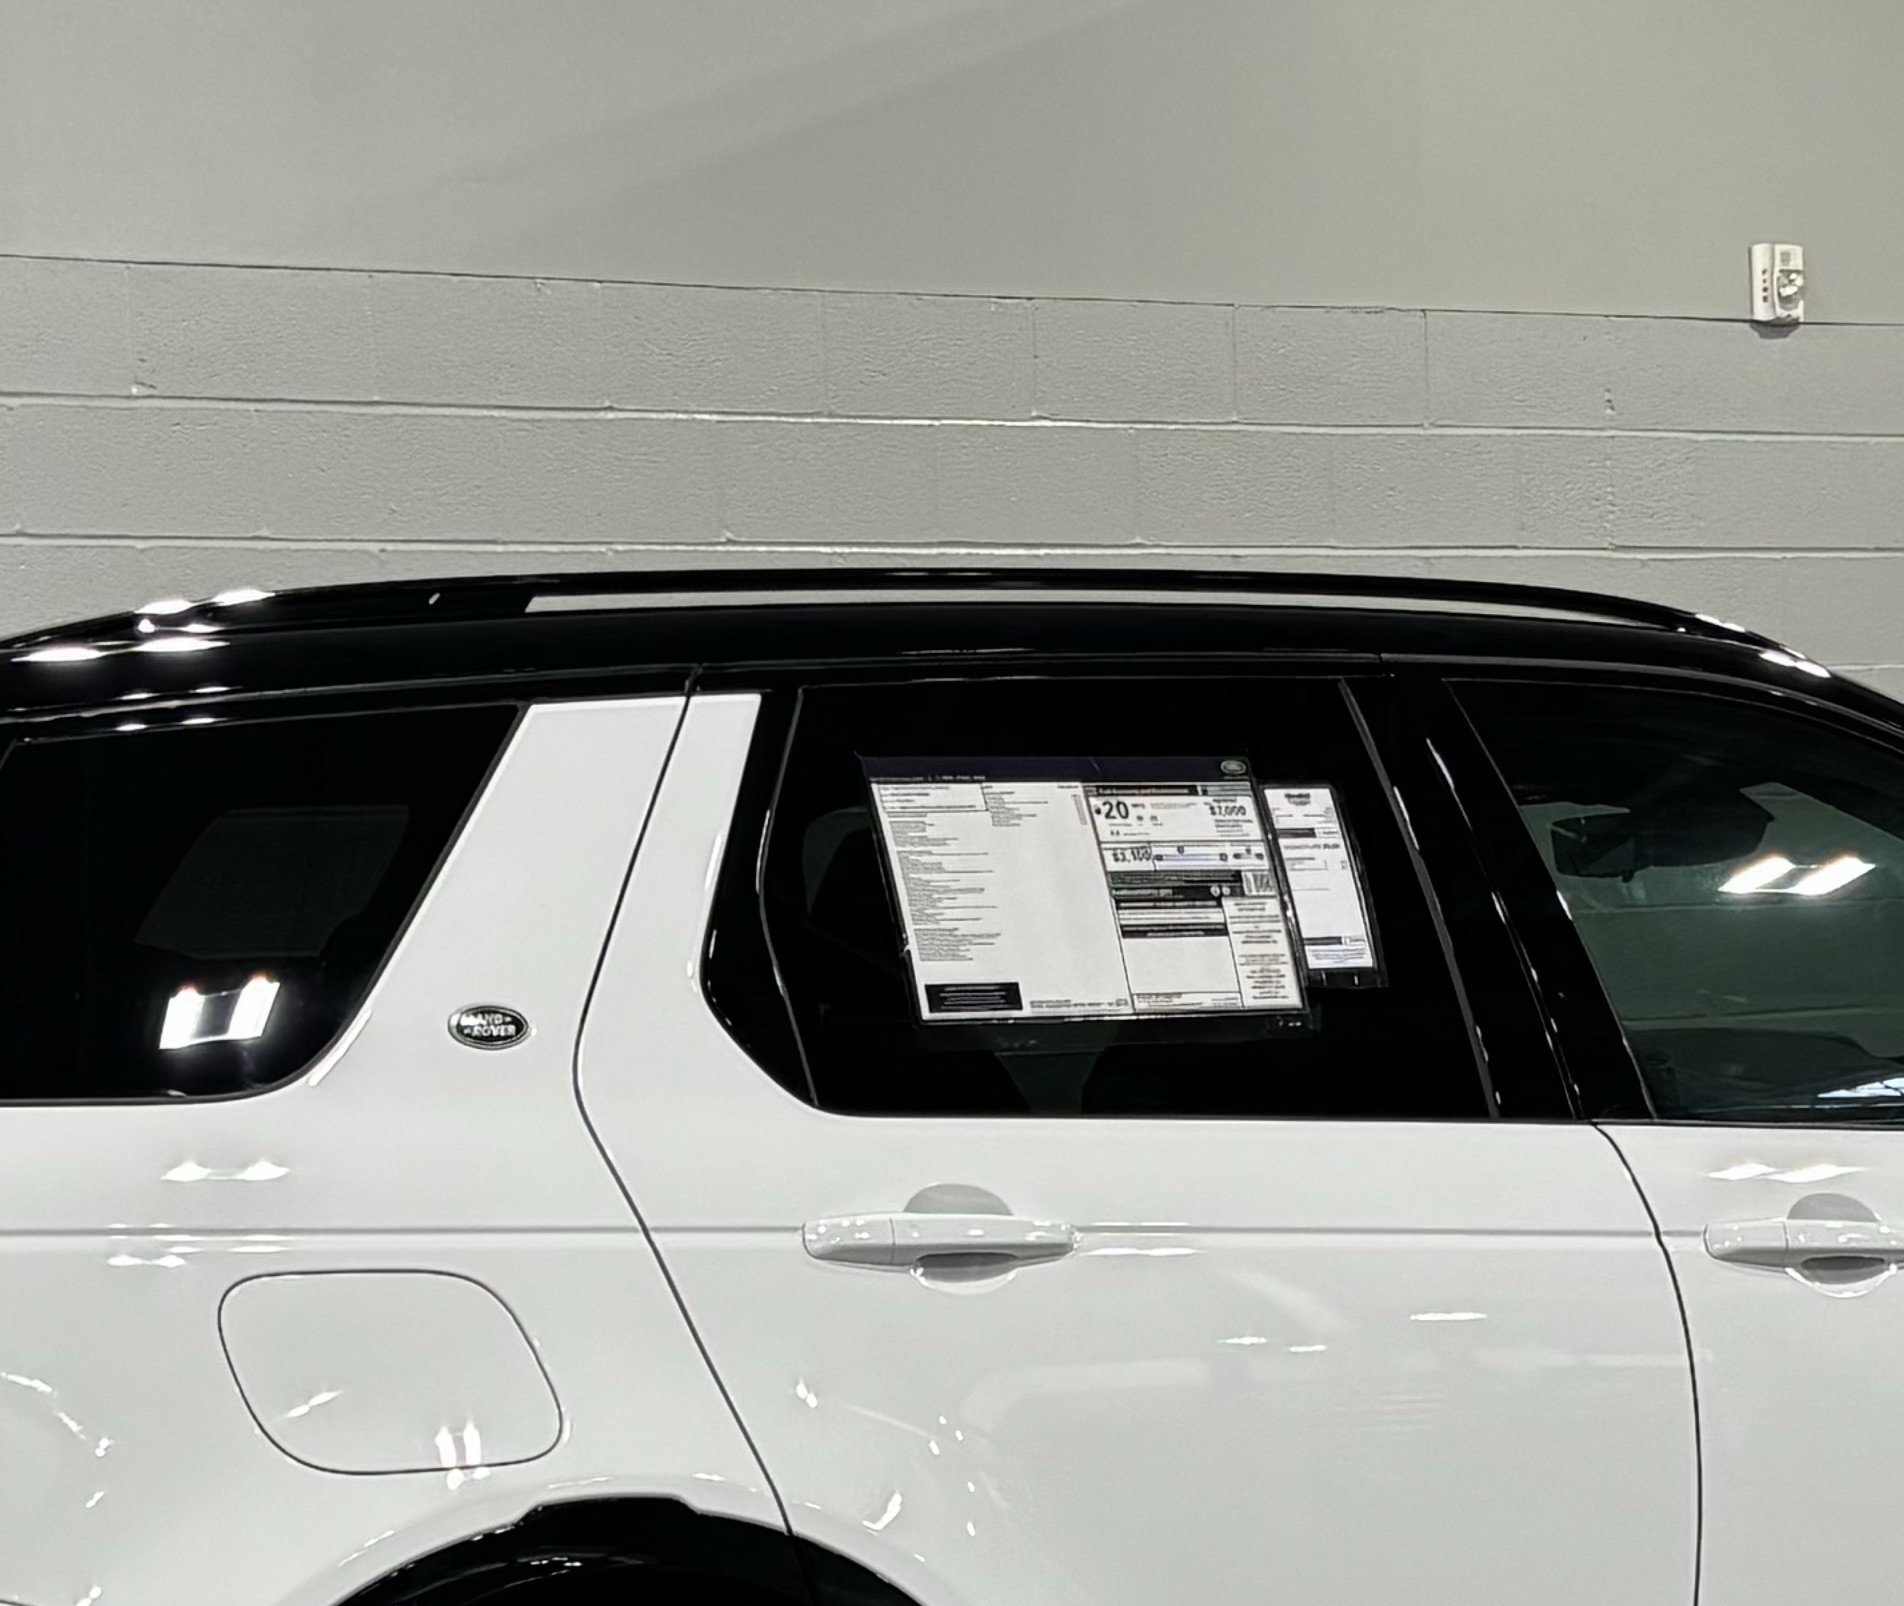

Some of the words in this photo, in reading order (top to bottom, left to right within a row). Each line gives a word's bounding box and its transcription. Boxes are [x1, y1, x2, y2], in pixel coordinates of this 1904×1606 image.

[1102, 800, 1129, 819] 20
[468, 1012, 503, 1025] AND
[472, 1024, 516, 1037] ROVER
